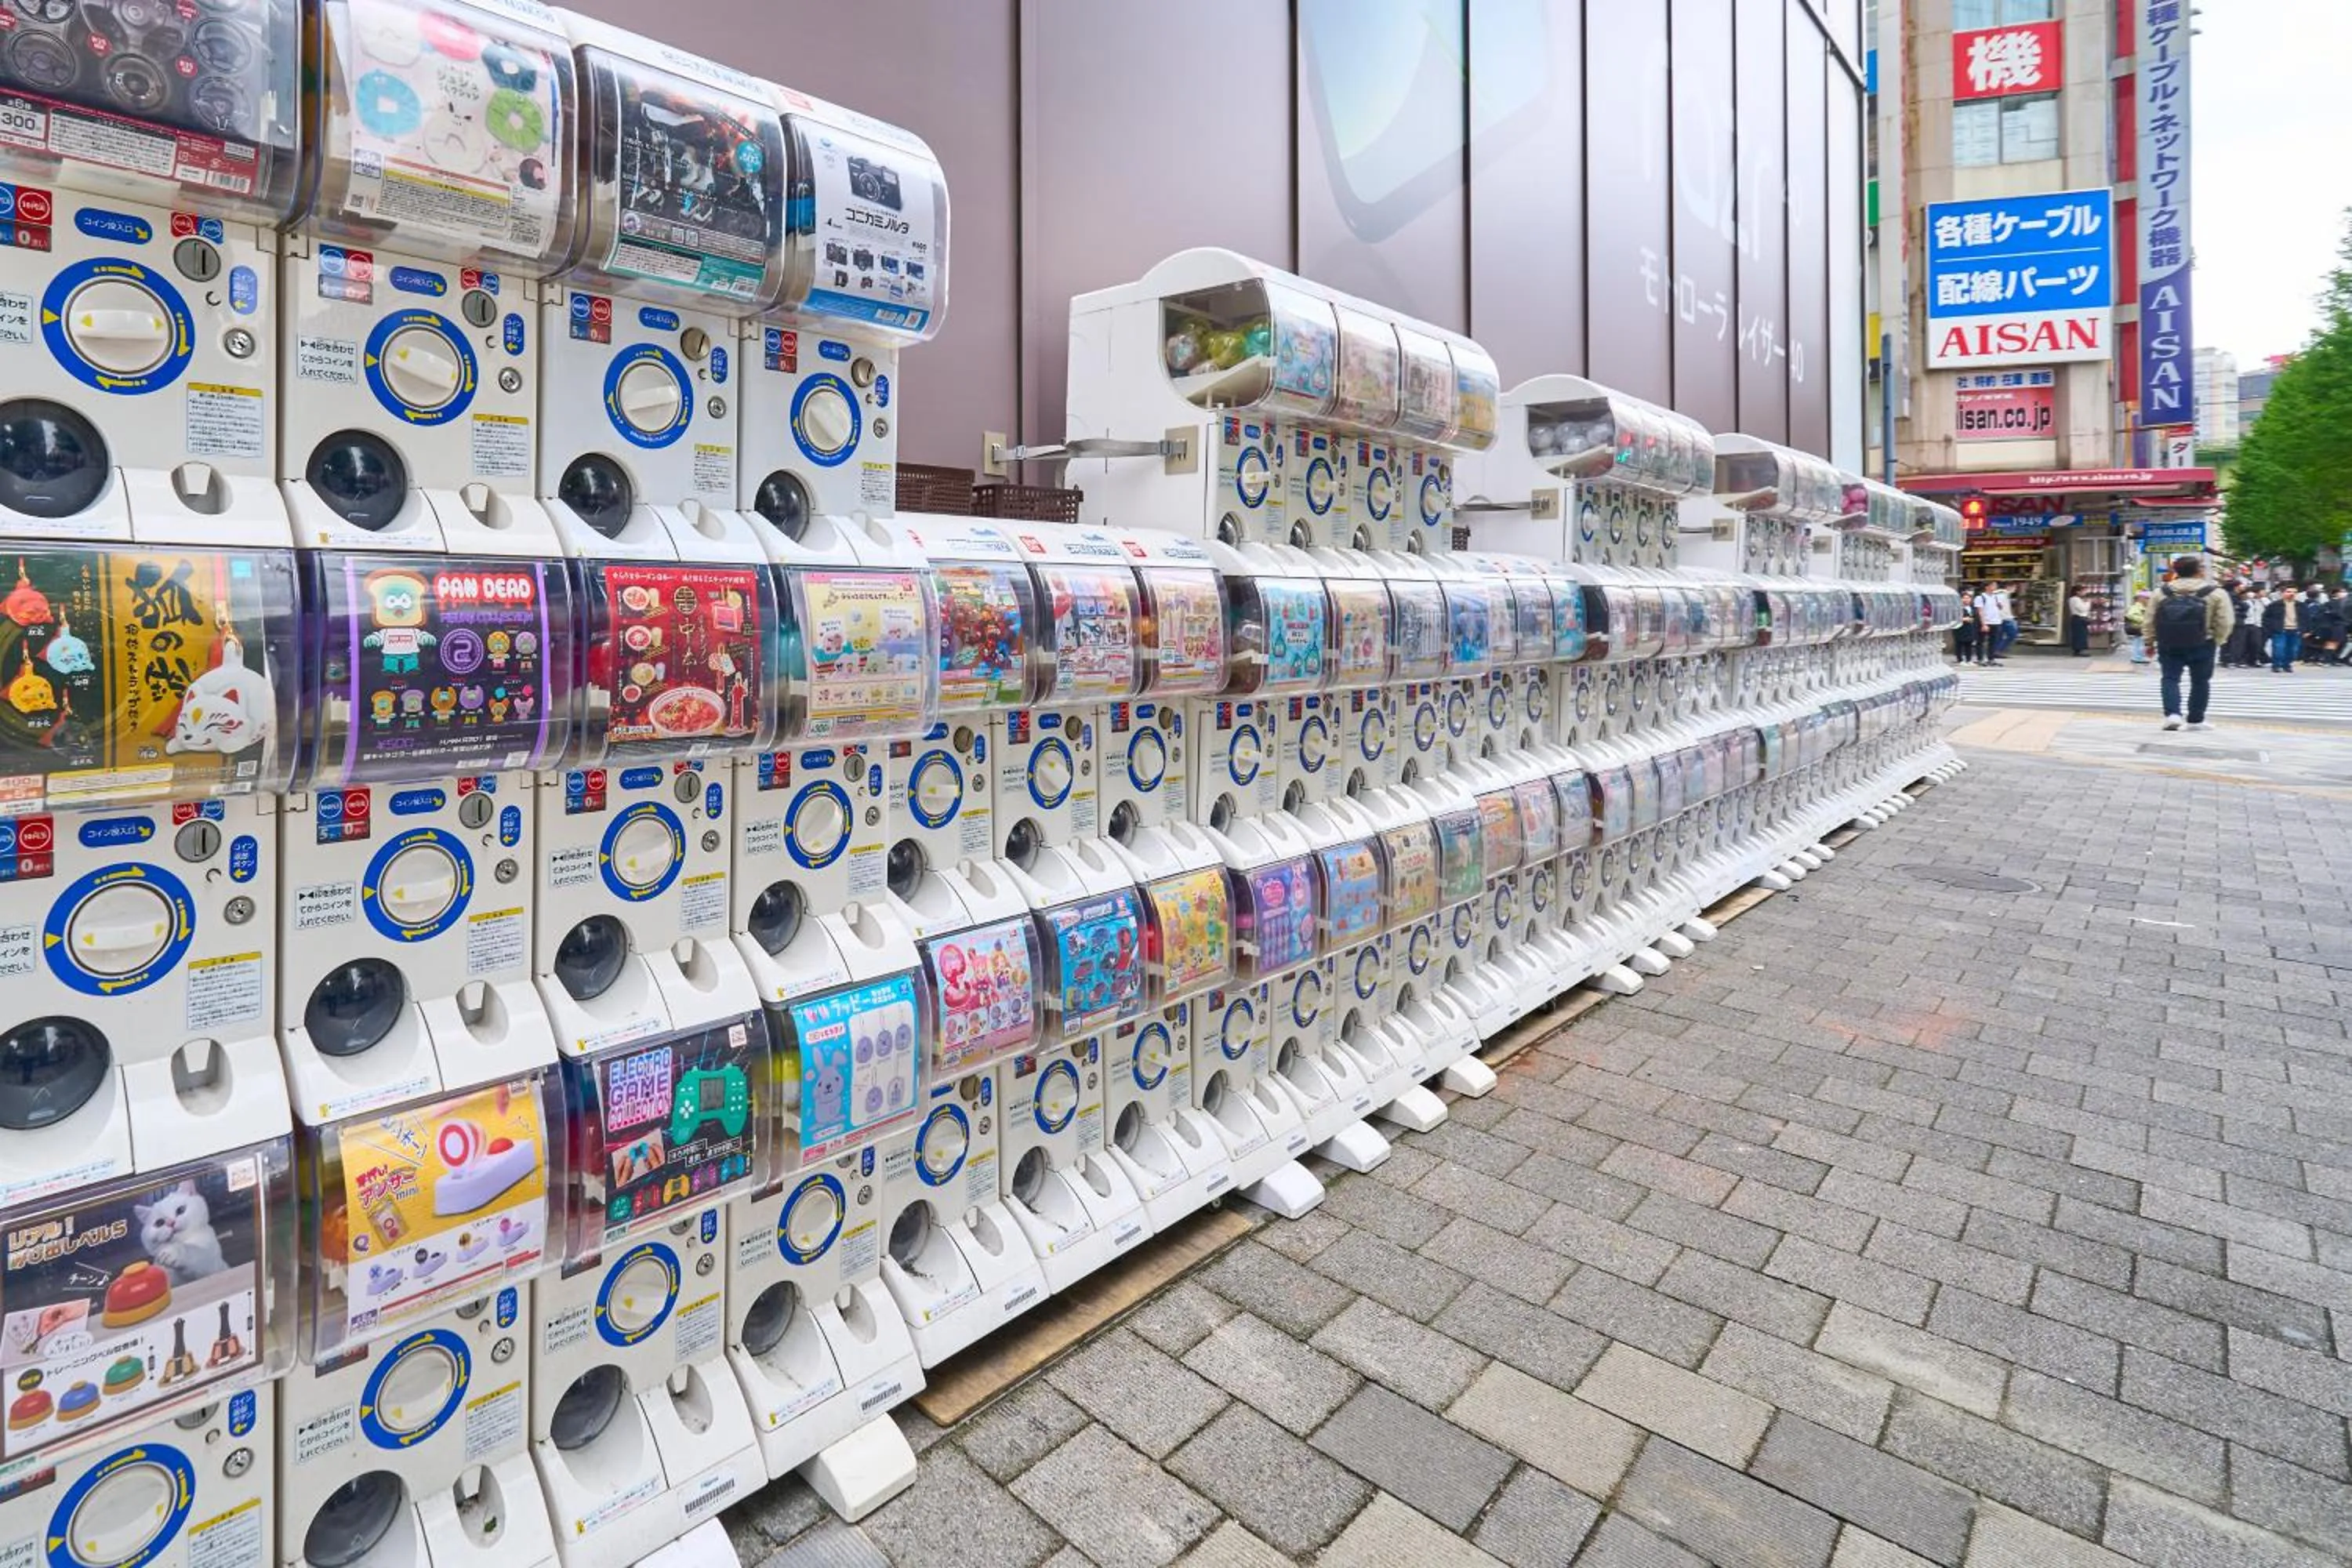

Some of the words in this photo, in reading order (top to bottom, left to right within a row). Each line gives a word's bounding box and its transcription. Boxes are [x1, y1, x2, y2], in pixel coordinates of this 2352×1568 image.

[1968, 31, 2042, 92] 機
[2, 112, 35, 131] 300
[2147, 0, 2181, 268] 種ケーブル・ネットワーク機器
[844, 207, 911, 235] コニカミノルタ
[1934, 205, 2103, 249] 各種ケーブル
[1937, 265, 2100, 307] 配線パーツ
[1937, 318, 2100, 358] AISAN
[2149, 285, 2182, 410] AISAN
[1957, 401, 2051, 431] isan.co.jp
[438, 576, 479, 600] PAN
[482, 577, 531, 600] DEAD
[609, 1047, 671, 1084] ELECTRO
[610, 1070, 670, 1106] GAME
[395, 1185, 419, 1200] mini
